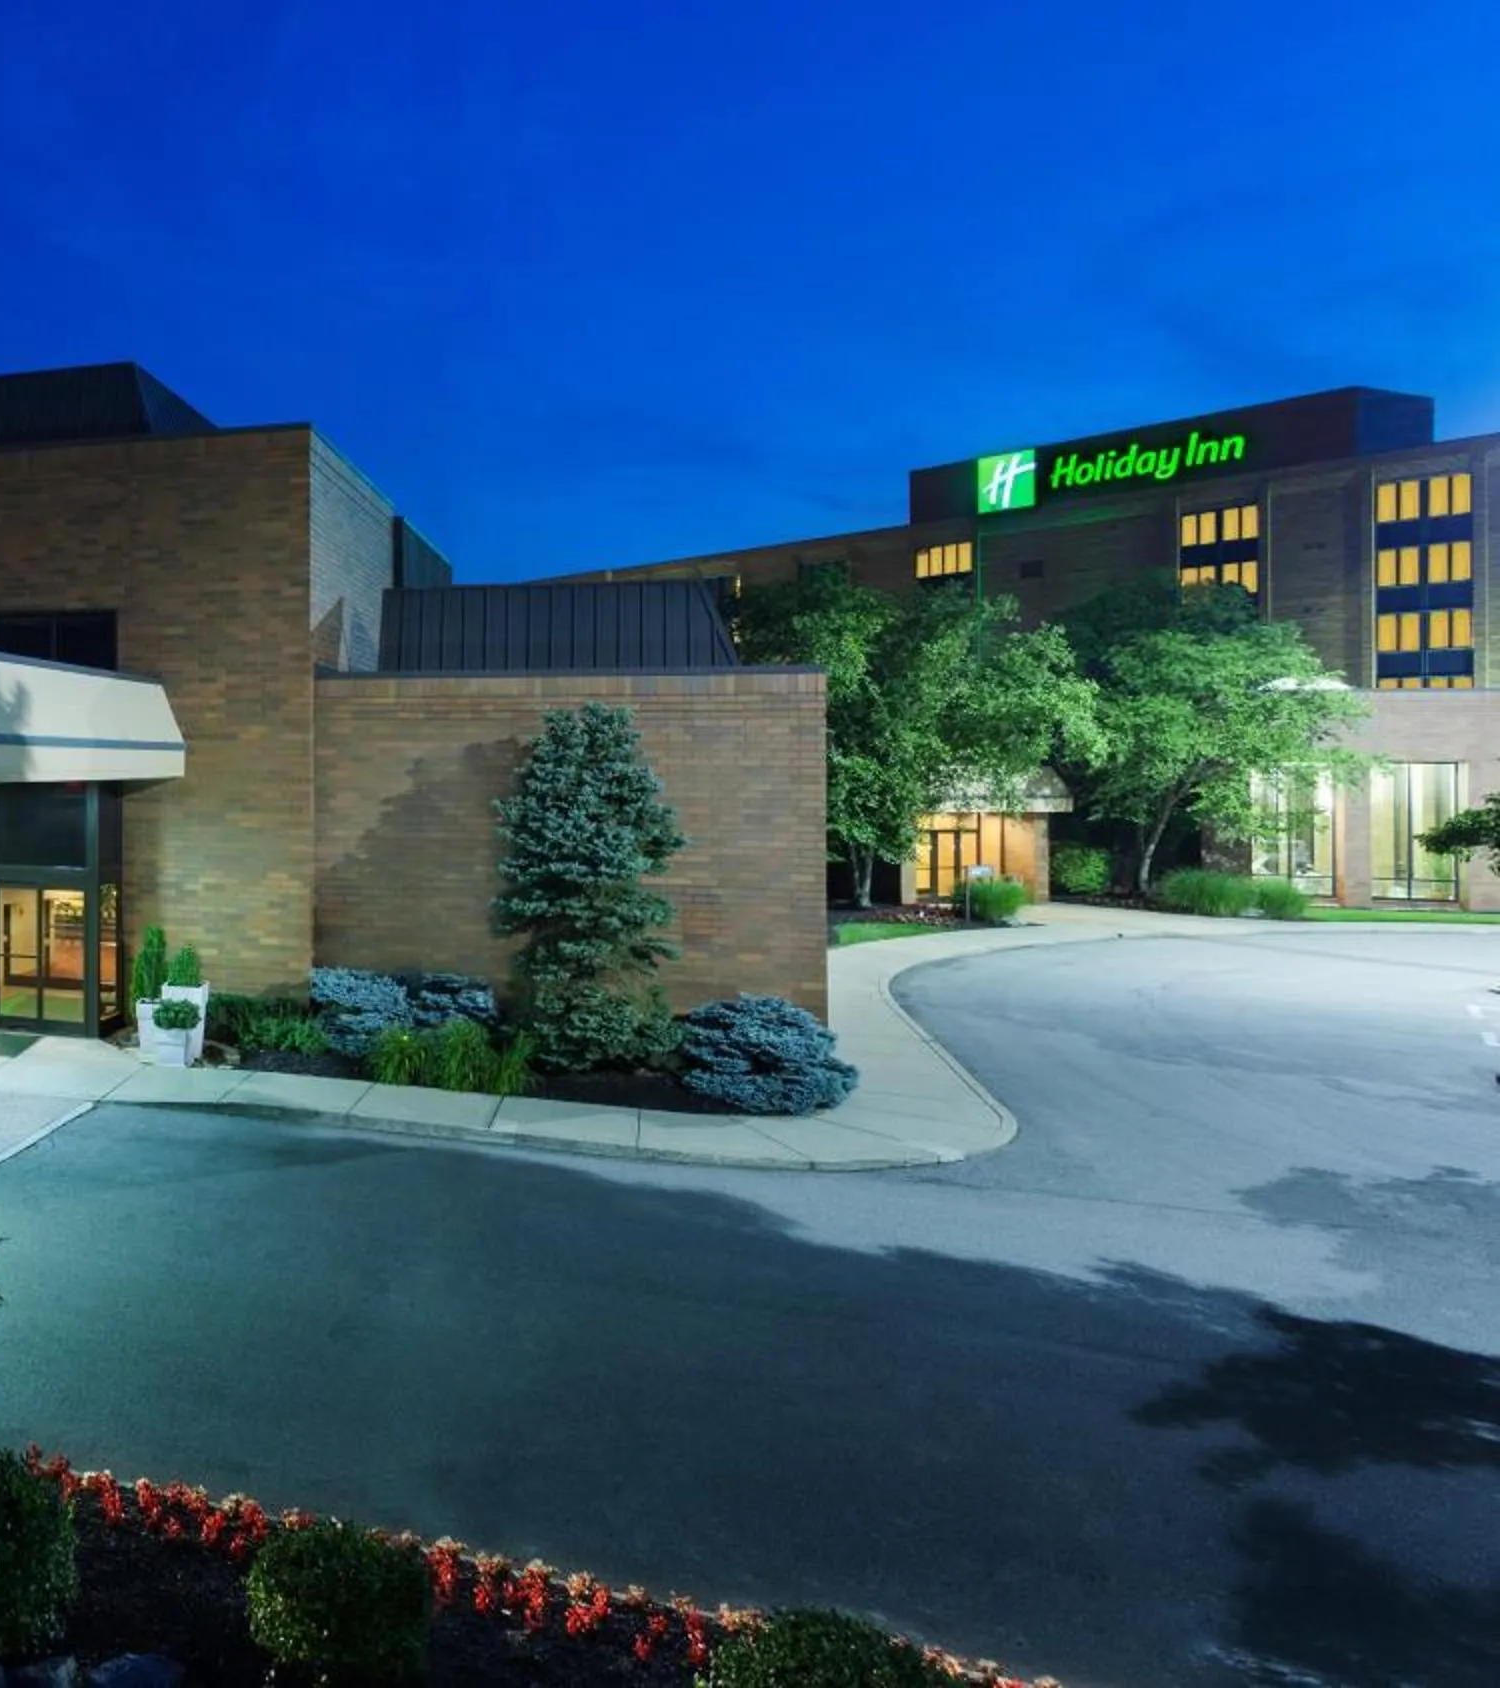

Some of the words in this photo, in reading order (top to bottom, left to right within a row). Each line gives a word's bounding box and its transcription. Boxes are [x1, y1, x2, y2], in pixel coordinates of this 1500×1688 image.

[983, 452, 1036, 509] H
[1050, 443, 1180, 488] Holiday
[1185, 431, 1245, 466] Inn
